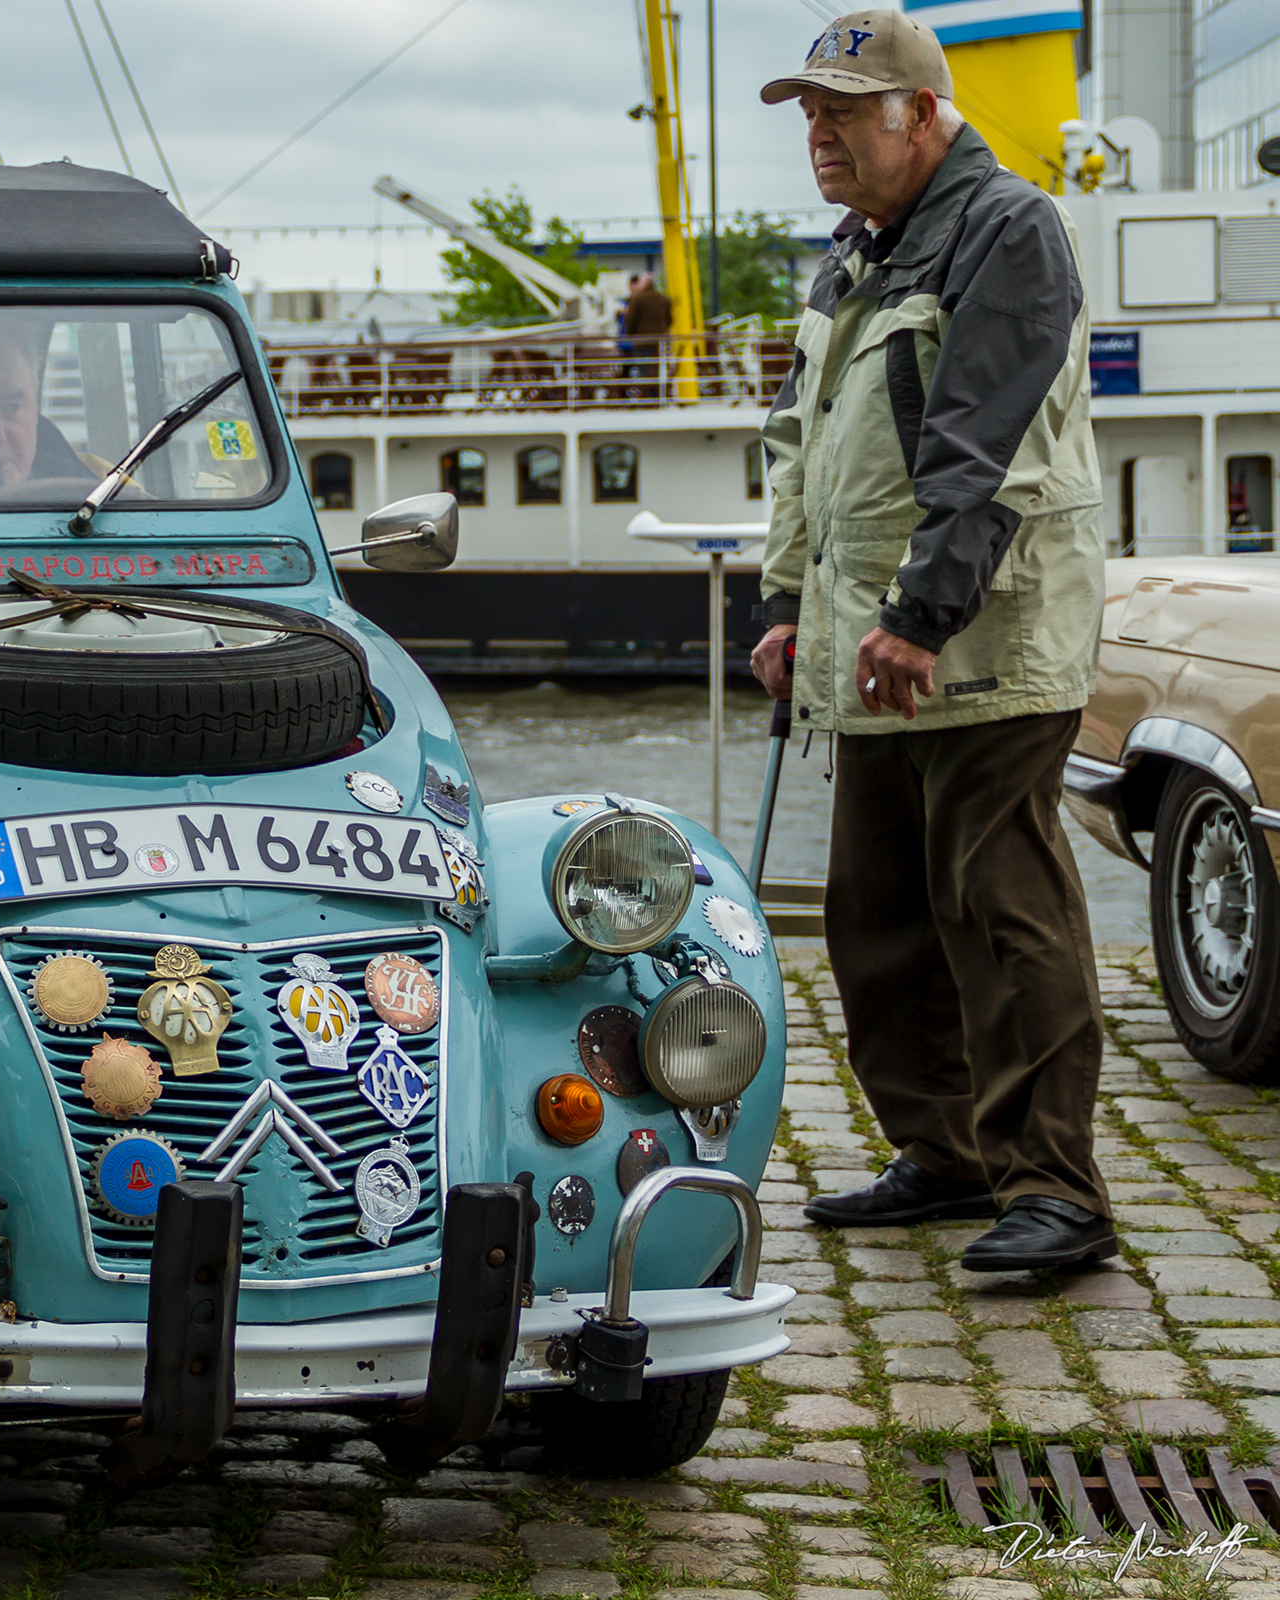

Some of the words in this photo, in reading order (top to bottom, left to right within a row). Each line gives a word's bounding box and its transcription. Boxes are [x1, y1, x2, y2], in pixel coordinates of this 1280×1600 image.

[172, 553, 269, 578] МИРА
[15, 820, 129, 886] HB
[177, 813, 240, 872] M
[256, 815, 440, 887] 6484
[158, 945, 200, 967] KARACHI
[87, 1063, 158, 1114] JUGOSLAVIJA
[371, 1053, 420, 1110] RAC
